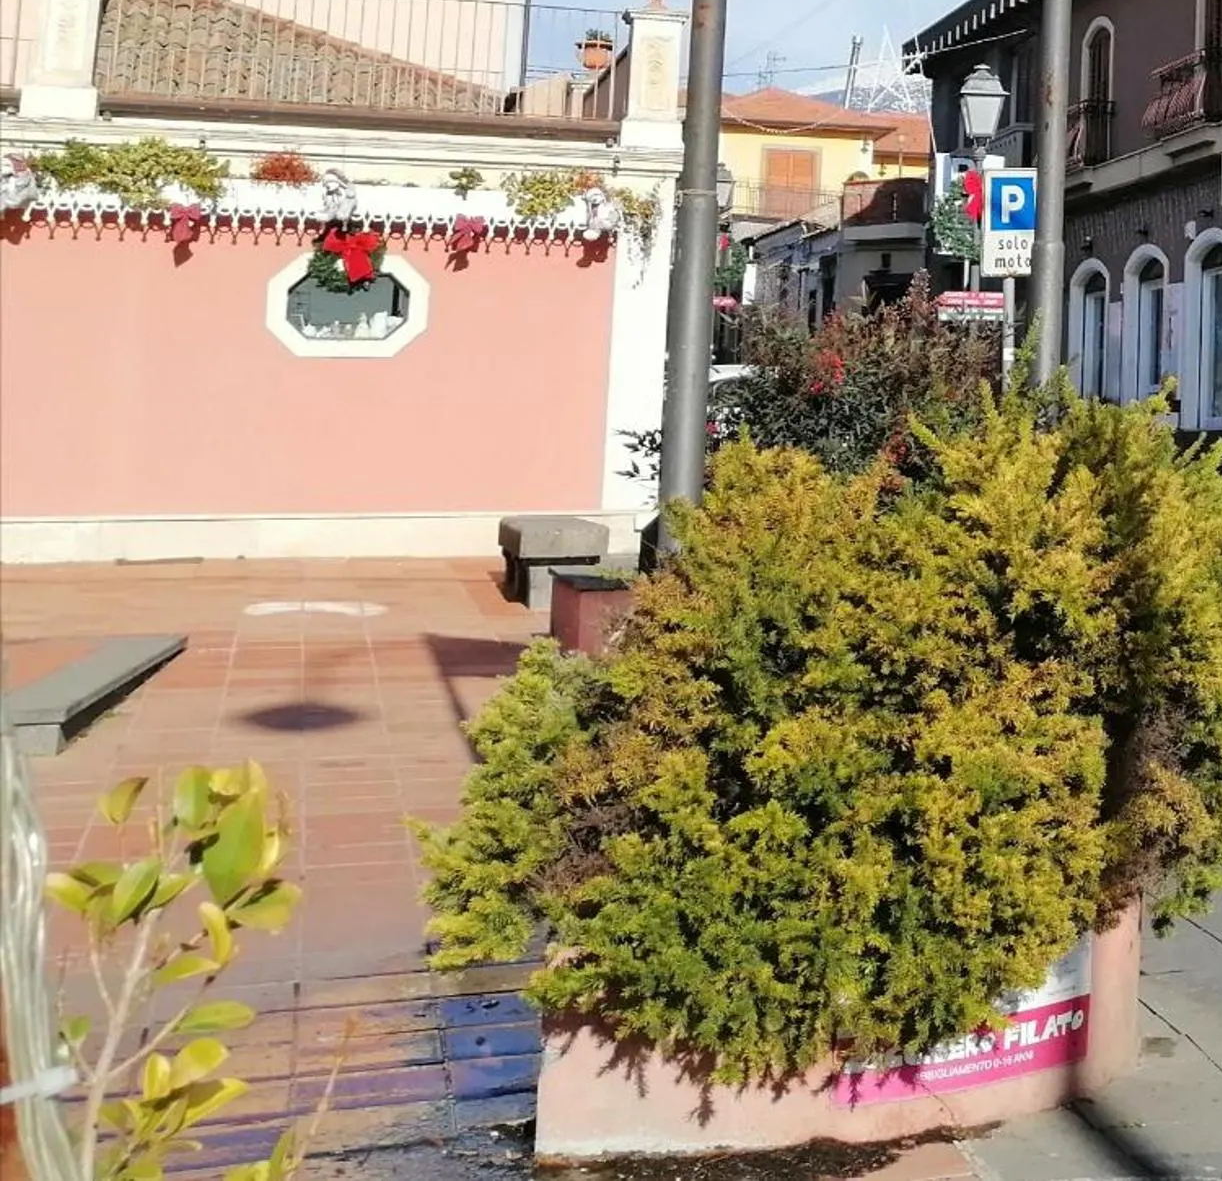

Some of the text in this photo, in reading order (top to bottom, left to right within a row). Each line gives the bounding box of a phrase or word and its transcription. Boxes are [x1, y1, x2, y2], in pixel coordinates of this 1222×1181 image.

[1001, 185, 1026, 224] P
[998, 235, 1029, 251] solo
[994, 256, 1032, 269] moto
[1003, 1009, 1084, 1051] FILATO
